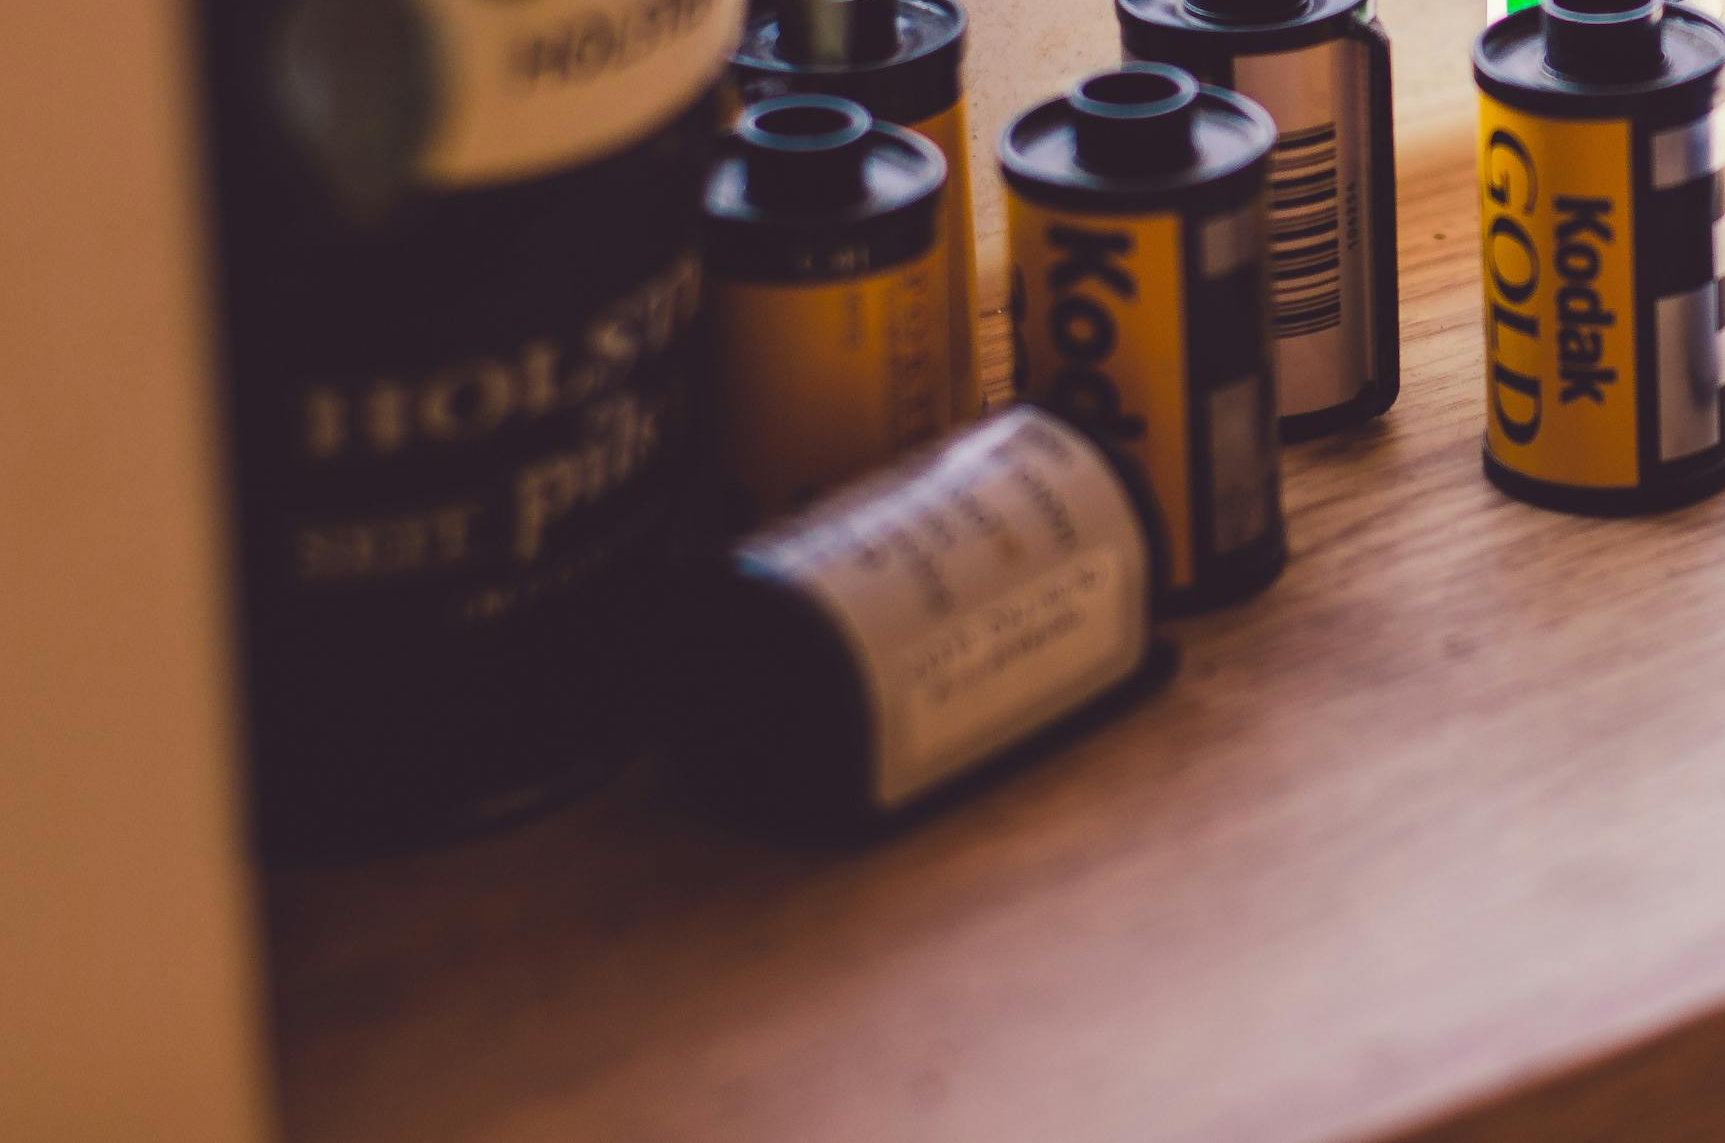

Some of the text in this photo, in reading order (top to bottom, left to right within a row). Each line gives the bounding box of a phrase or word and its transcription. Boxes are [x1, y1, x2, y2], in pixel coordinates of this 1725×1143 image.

[1045, 225, 1149, 445] Kod
[1485, 126, 1543, 447] GOLD
[1551, 194, 1618, 407] Kodak
